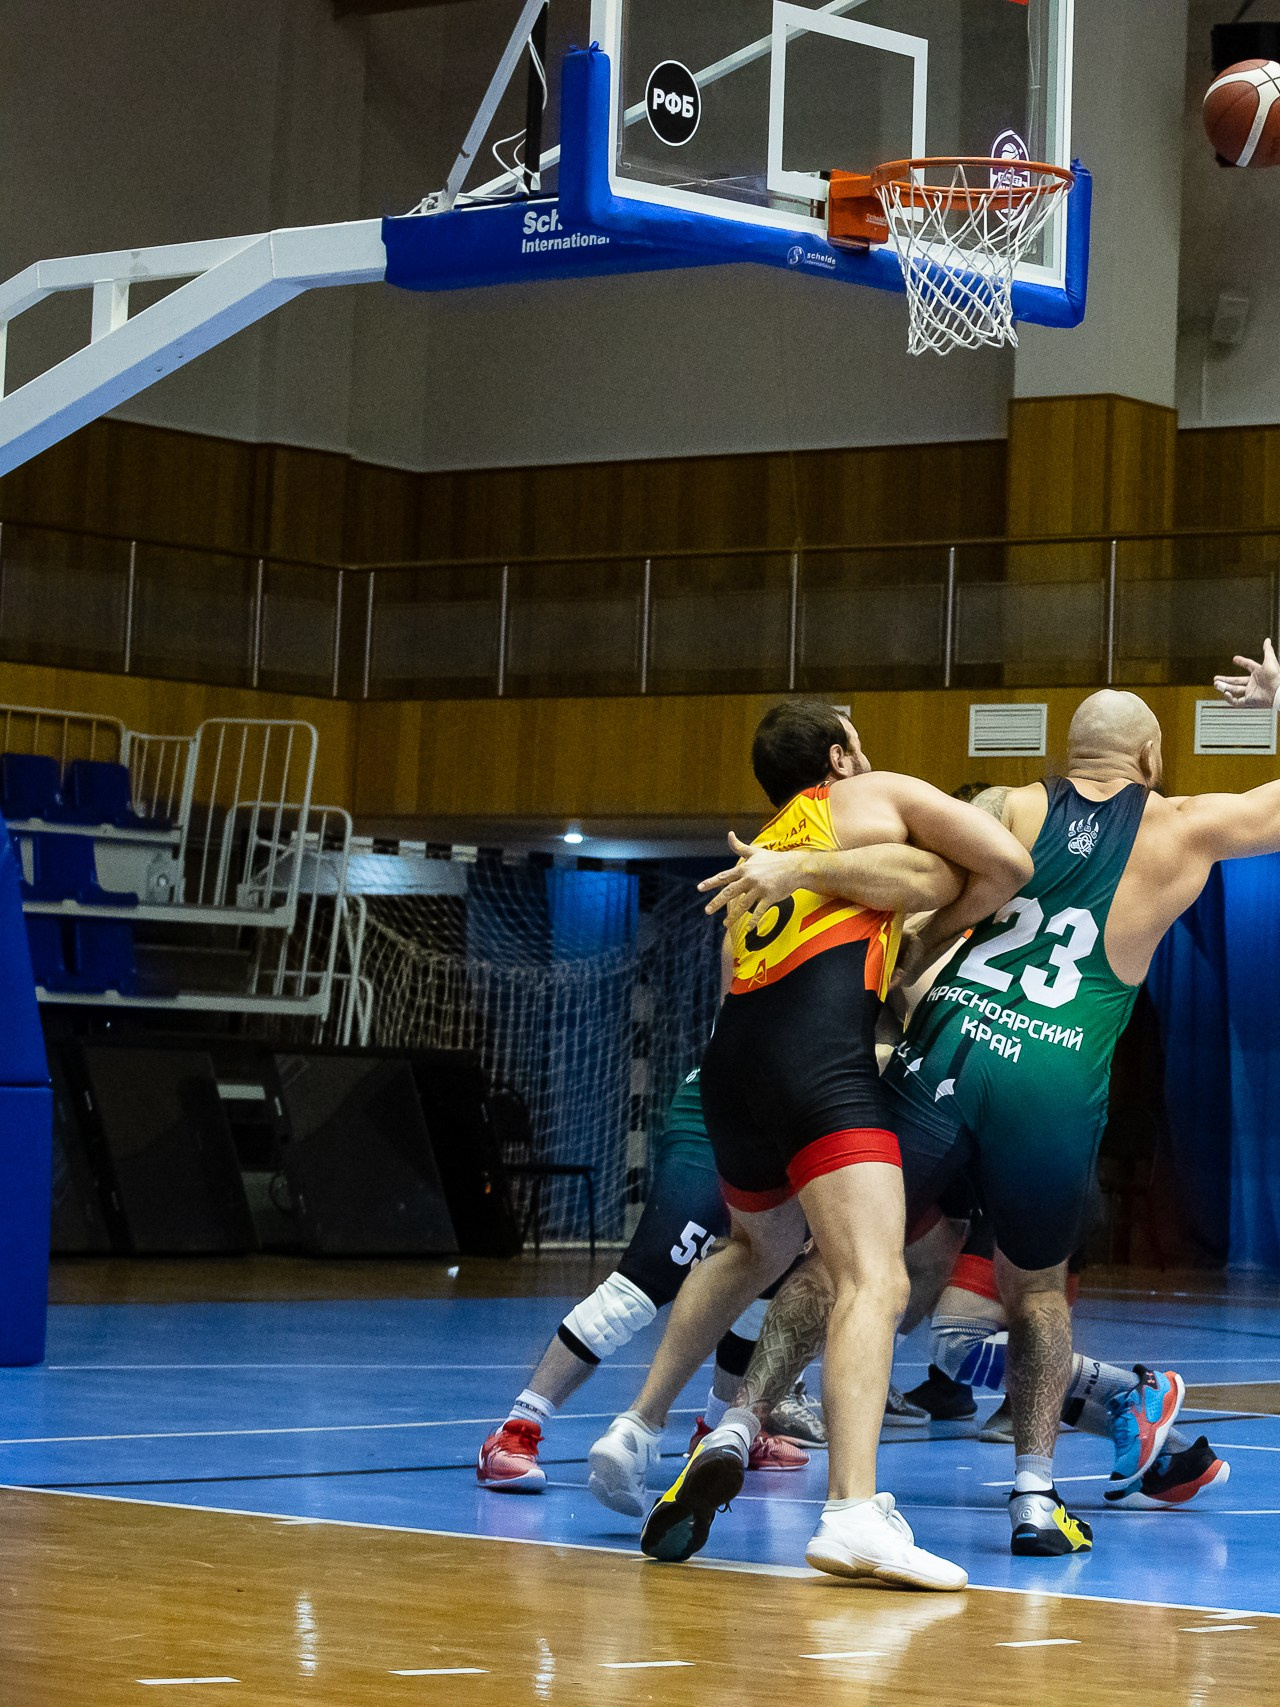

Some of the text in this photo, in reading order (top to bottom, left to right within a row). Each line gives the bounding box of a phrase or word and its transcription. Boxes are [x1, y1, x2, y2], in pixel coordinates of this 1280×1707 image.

[652, 87, 694, 118] РФБ
[806, 252, 836, 265] schelde
[956, 896, 1100, 1009] 23
[926, 985, 1084, 1051] КРАСНОЯРСКИЙ
[960, 1015, 1023, 1063] КРАЙ
